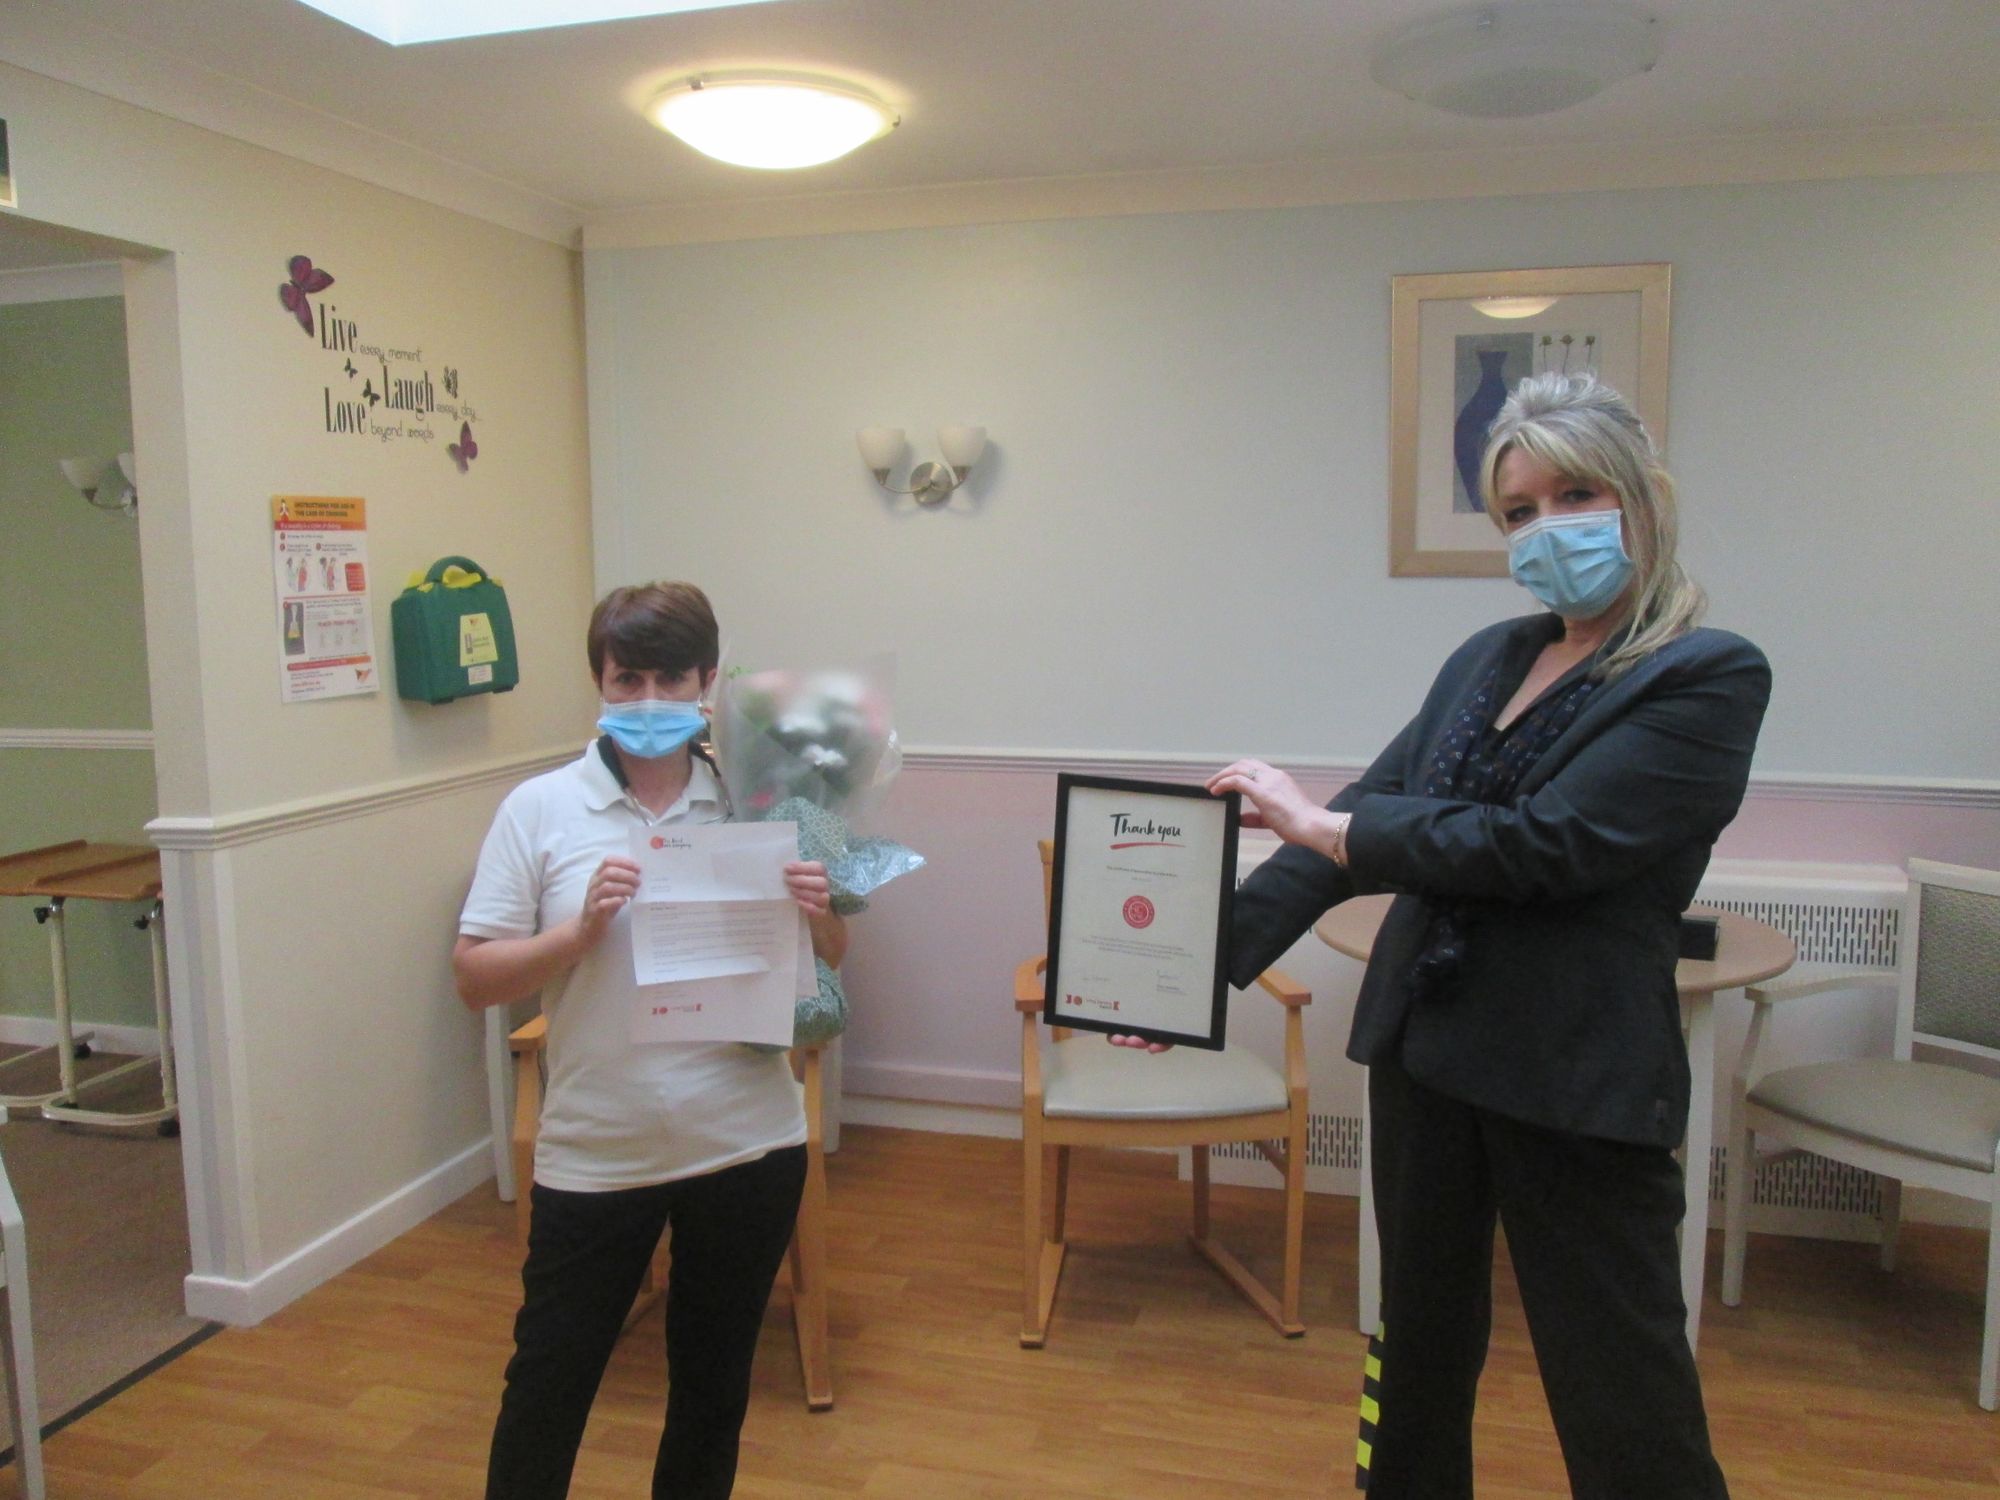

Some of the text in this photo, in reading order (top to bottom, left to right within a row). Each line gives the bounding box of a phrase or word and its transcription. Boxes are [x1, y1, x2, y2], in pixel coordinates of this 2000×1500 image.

[320, 303, 423, 363] Live every moment
[325, 387, 434, 443] Love beyond words
[383, 365, 434, 421] Laugh
[1110, 813, 1181, 842] Thank you
